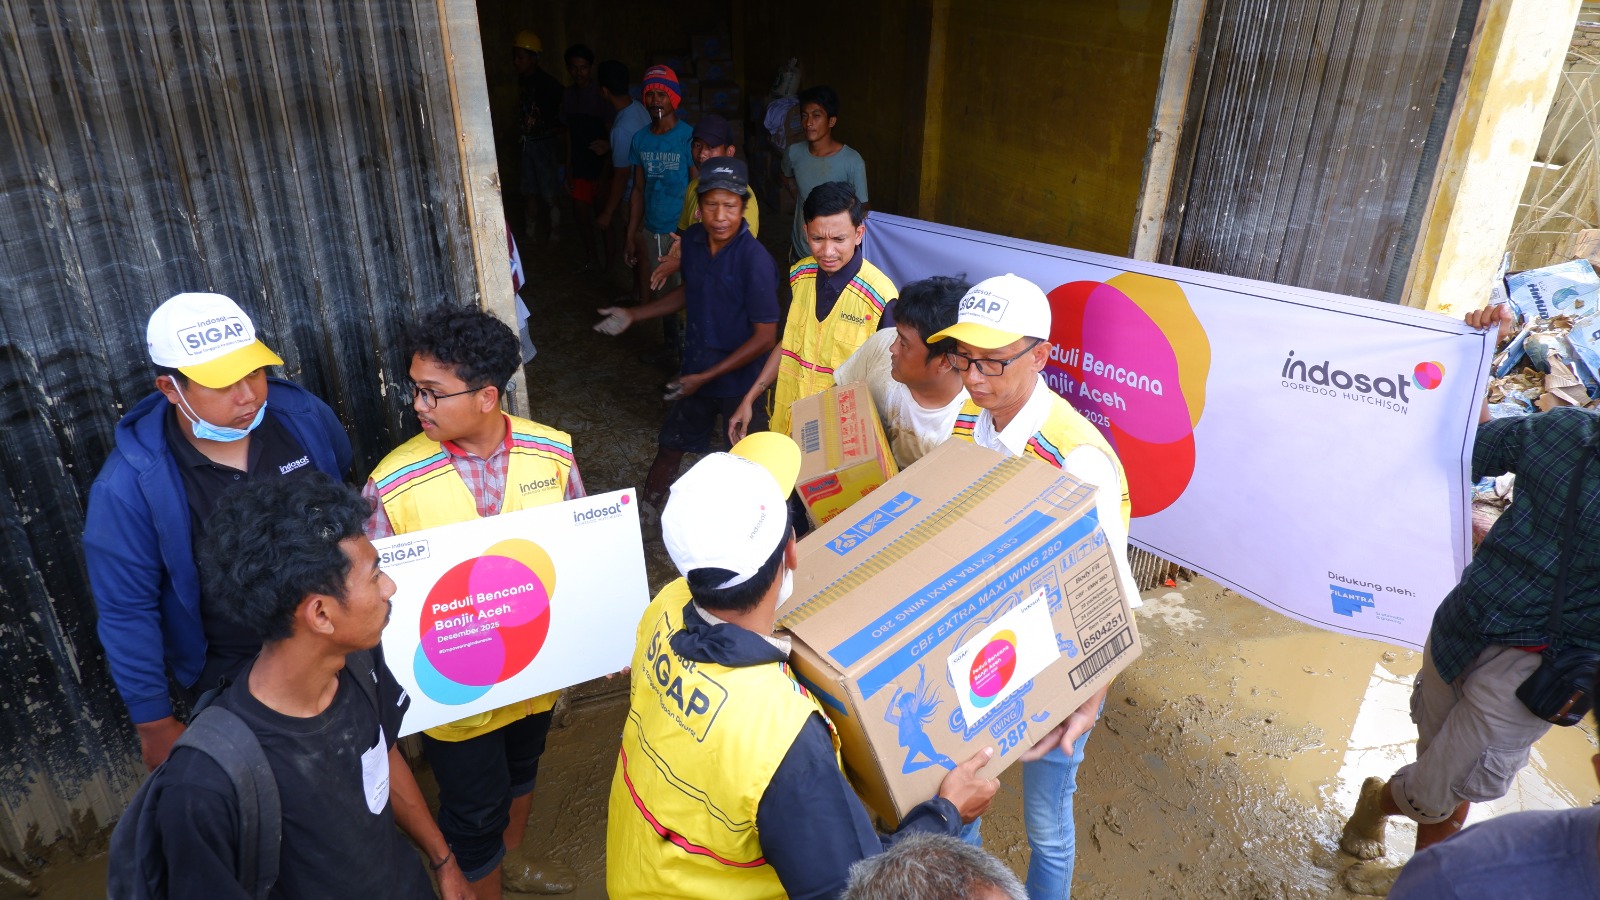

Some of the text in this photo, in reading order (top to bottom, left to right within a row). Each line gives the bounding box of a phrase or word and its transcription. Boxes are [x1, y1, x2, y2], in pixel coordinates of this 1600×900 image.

[186, 322, 243, 349] SIGAP
[1049, 344, 1163, 396] duli Bencana
[1281, 350, 1411, 404] indosat
[1040, 371, 1127, 411] anjir Aceh
[1281, 380, 1408, 415] OOREDOO HUTCHISON
[1084, 409, 1111, 428] 2025
[519, 477, 556, 493] indosat
[573, 502, 622, 523] indosat
[381, 545, 426, 564] SIGAP
[997, 537, 1018, 555] CBF
[956, 553, 996, 579] EXTRA
[927, 578, 958, 600] MAXI
[1328, 571, 1416, 598] Didukung oleh:
[1330, 589, 1374, 604] FILANTRA
[432, 582, 534, 615] Peduli Bencana
[895, 597, 929, 622] WING
[910, 633, 935, 657] CBF
[937, 603, 977, 637] EXTRA
[978, 579, 1008, 606] MAXI
[1008, 556, 1039, 583] WING
[435, 603, 511, 631] Banjir Aceh
[437, 621, 500, 643] Desember 2025
[1083, 613, 1123, 649] 6504251
[647, 630, 710, 718] SIGAP
[993, 711, 1016, 733] WING
[997, 720, 1028, 757] 28P
